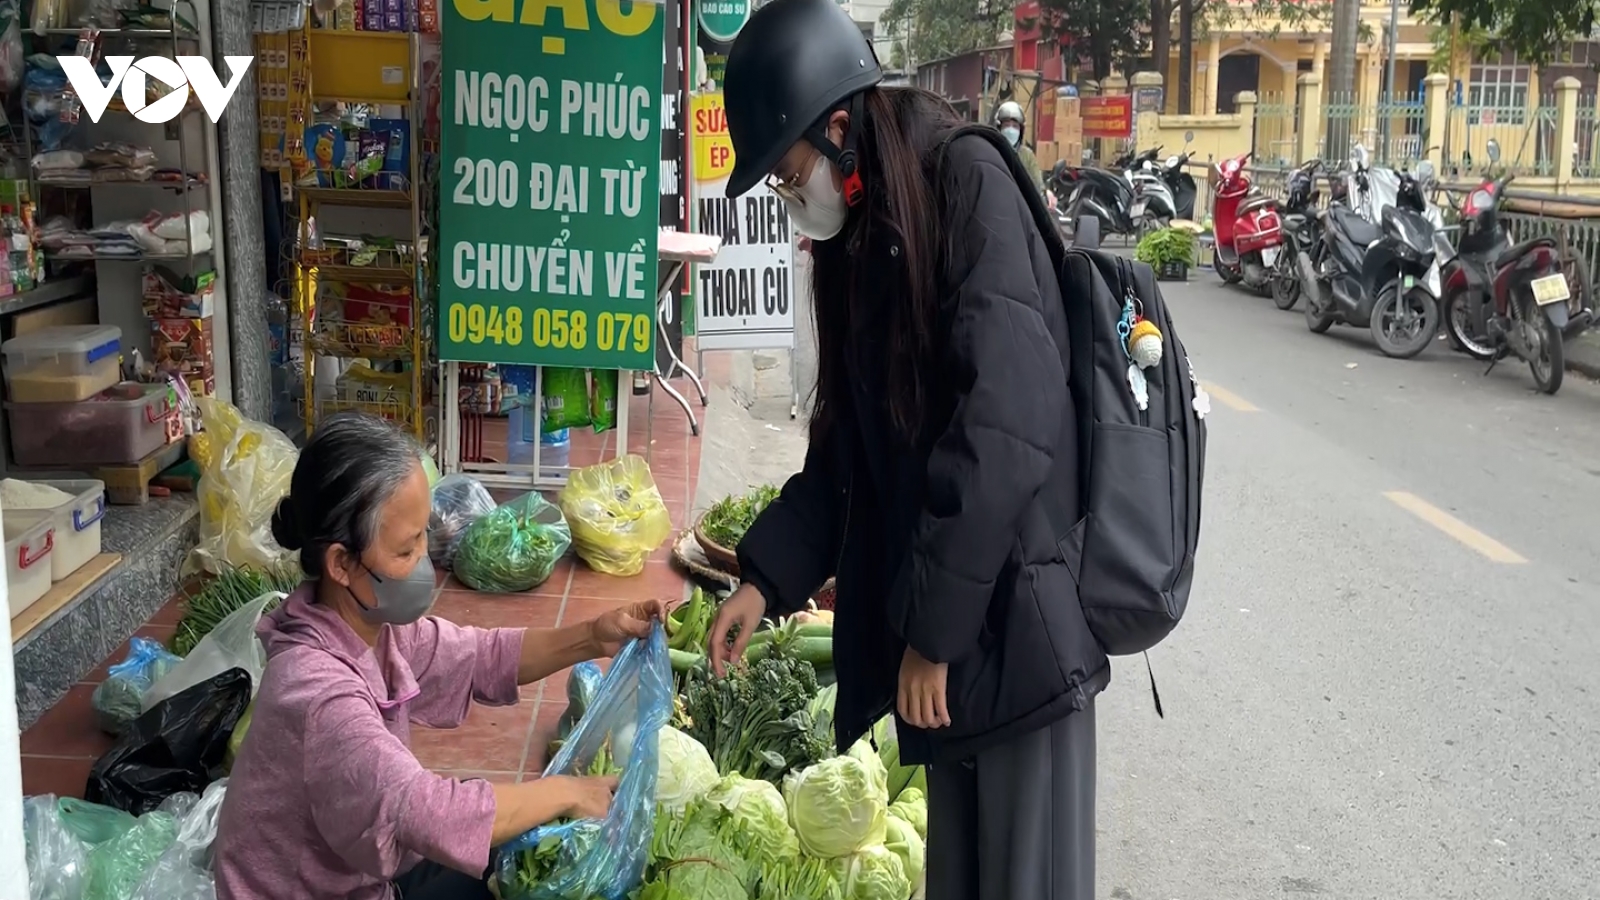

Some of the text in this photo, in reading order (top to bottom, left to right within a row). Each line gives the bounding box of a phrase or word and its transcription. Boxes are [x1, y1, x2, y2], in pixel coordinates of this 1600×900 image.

[702, 2, 745, 15] BAO CAO SU
[454, 70, 650, 142] NGỌC PHÚC
[710, 142, 730, 169] ÉP
[453, 157, 519, 208] 200
[529, 162, 589, 223] ĐẠI
[600, 160, 647, 217] TỪ
[699, 197, 740, 246] MUA
[453, 229, 646, 299] CHUYỂN VỀ
[700, 267, 757, 325] THOẠI
[763, 259, 789, 316] CŨ
[449, 302, 650, 353] 0948 058 079
